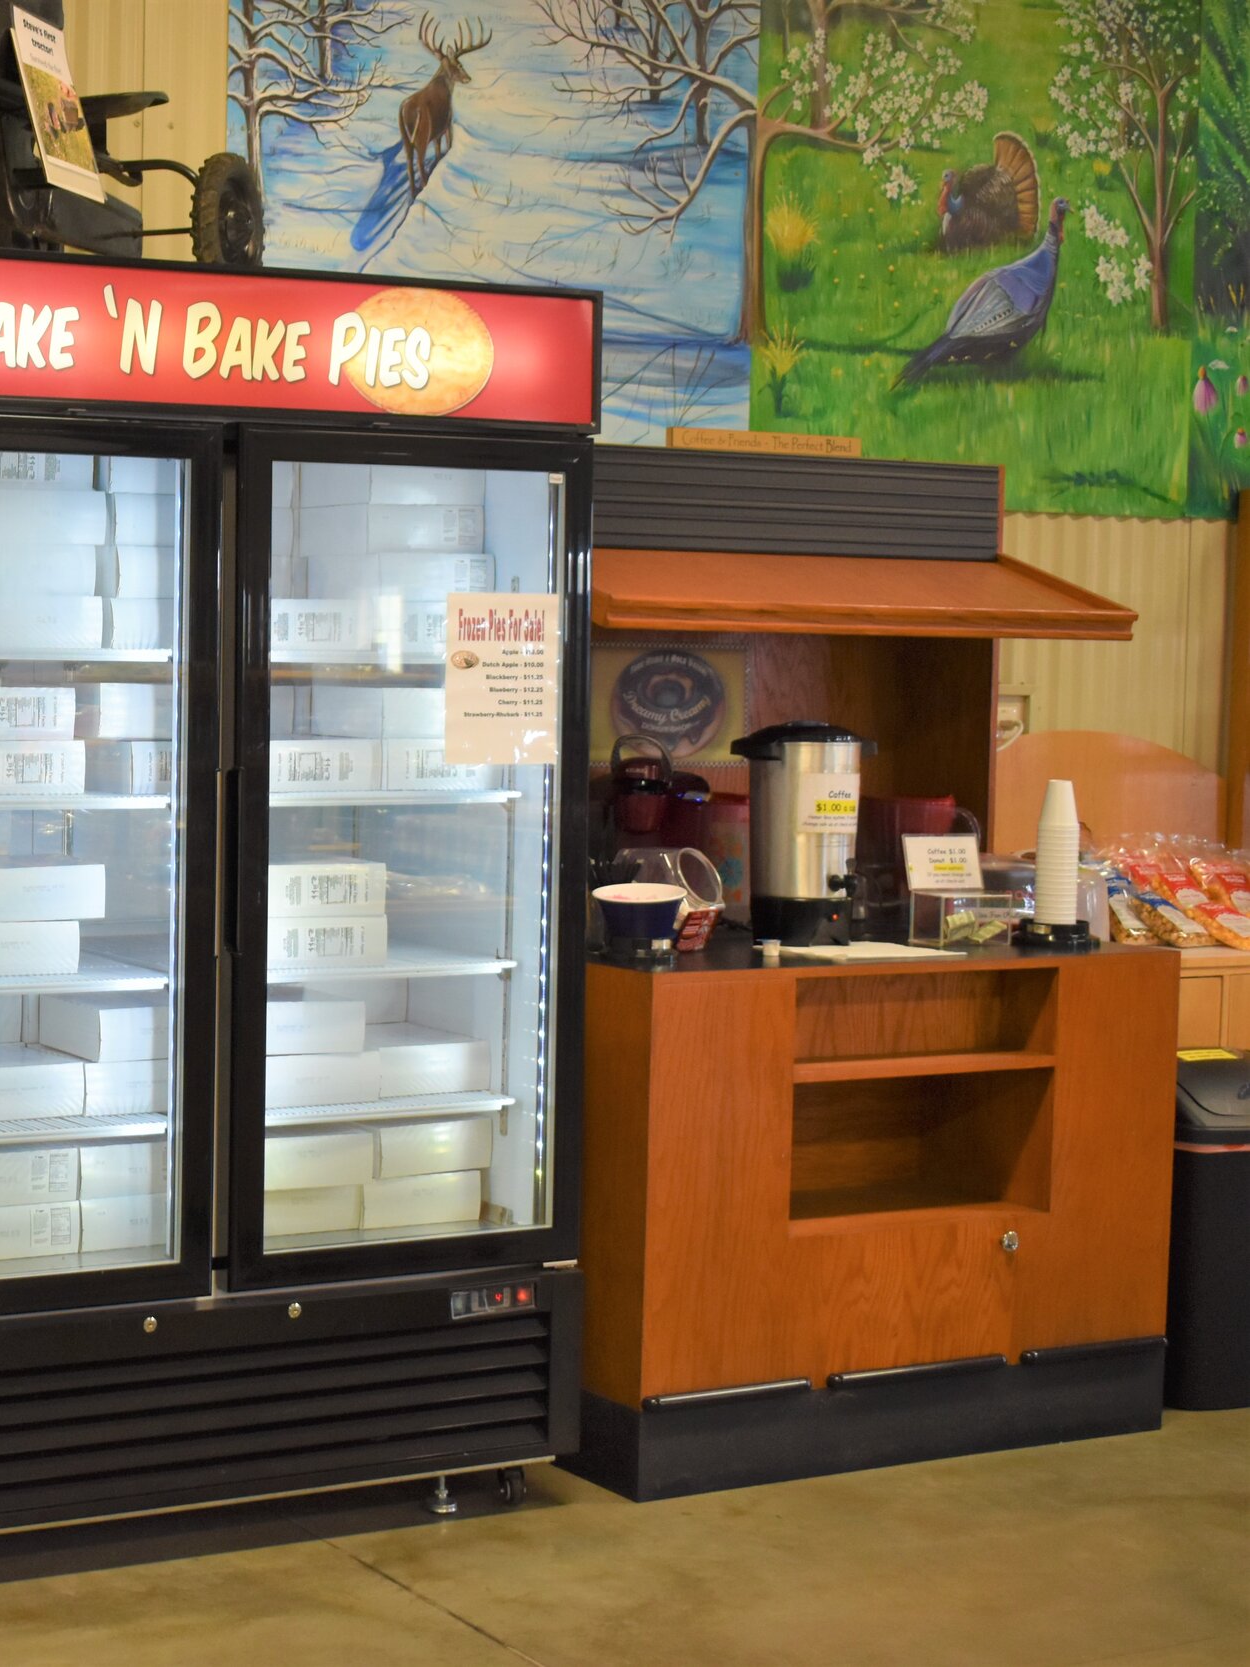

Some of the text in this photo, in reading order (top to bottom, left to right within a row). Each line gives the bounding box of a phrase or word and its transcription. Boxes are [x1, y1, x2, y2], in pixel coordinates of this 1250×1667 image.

[23, 18, 43, 36] Steve's
[104, 284, 163, 376] 'N
[182, 302, 311, 383] BAKE
[328, 312, 432, 390] PIES
[681, 431, 716, 444] Coffee
[728, 434, 761, 447] Friends
[773, 436, 789, 449] The
[792, 436, 824, 450] Perfect
[826, 438, 852, 452] Blend
[458, 608, 486, 641] Frozen
[488, 608, 506, 642] Pies
[508, 609, 522, 642] For
[623, 690, 711, 725] Dreamy Creamy
[828, 790, 851, 798] Coffee
